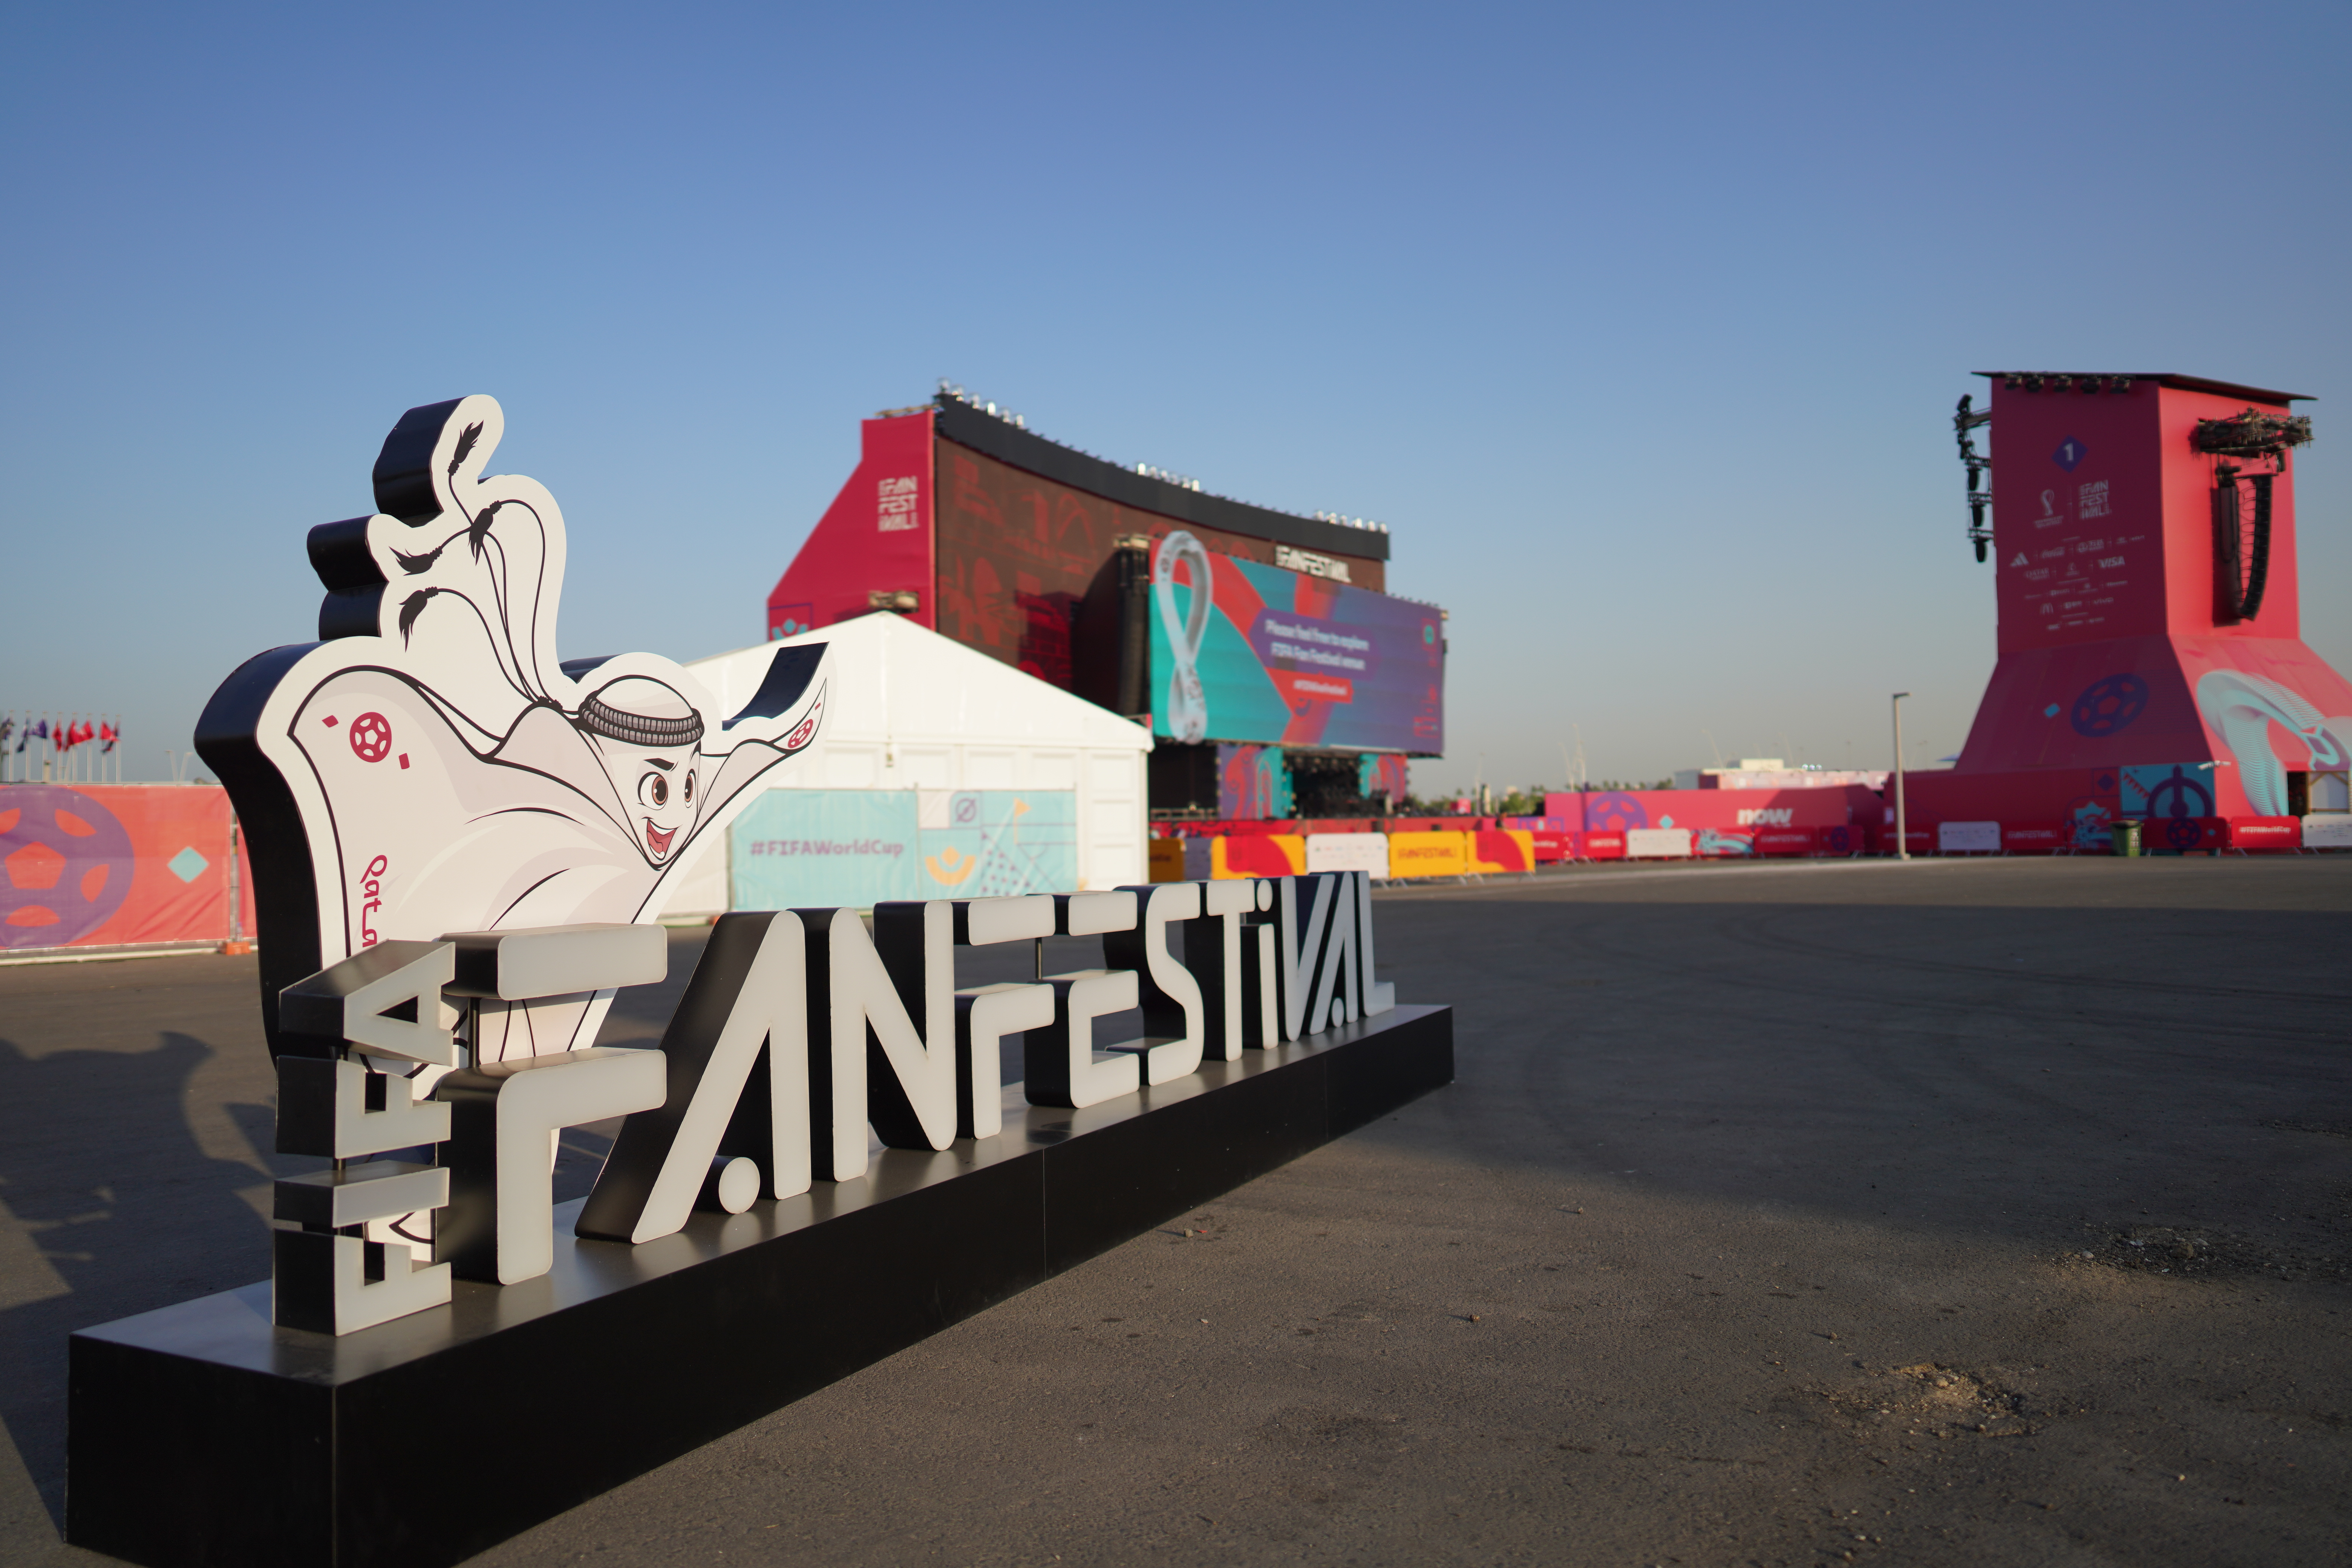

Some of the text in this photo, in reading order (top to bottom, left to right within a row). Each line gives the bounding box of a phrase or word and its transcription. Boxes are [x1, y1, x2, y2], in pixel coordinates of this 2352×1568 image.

[2064, 443, 2073, 462] 1
[878, 493, 918, 514] FEST
[2079, 491, 2109, 508] FEST
[2098, 556, 2125, 568] VISA
[750, 839, 903, 858] #FIFAWorldCup
[360, 855, 387, 947] Qata
[333, 942, 455, 1336] FIFA
